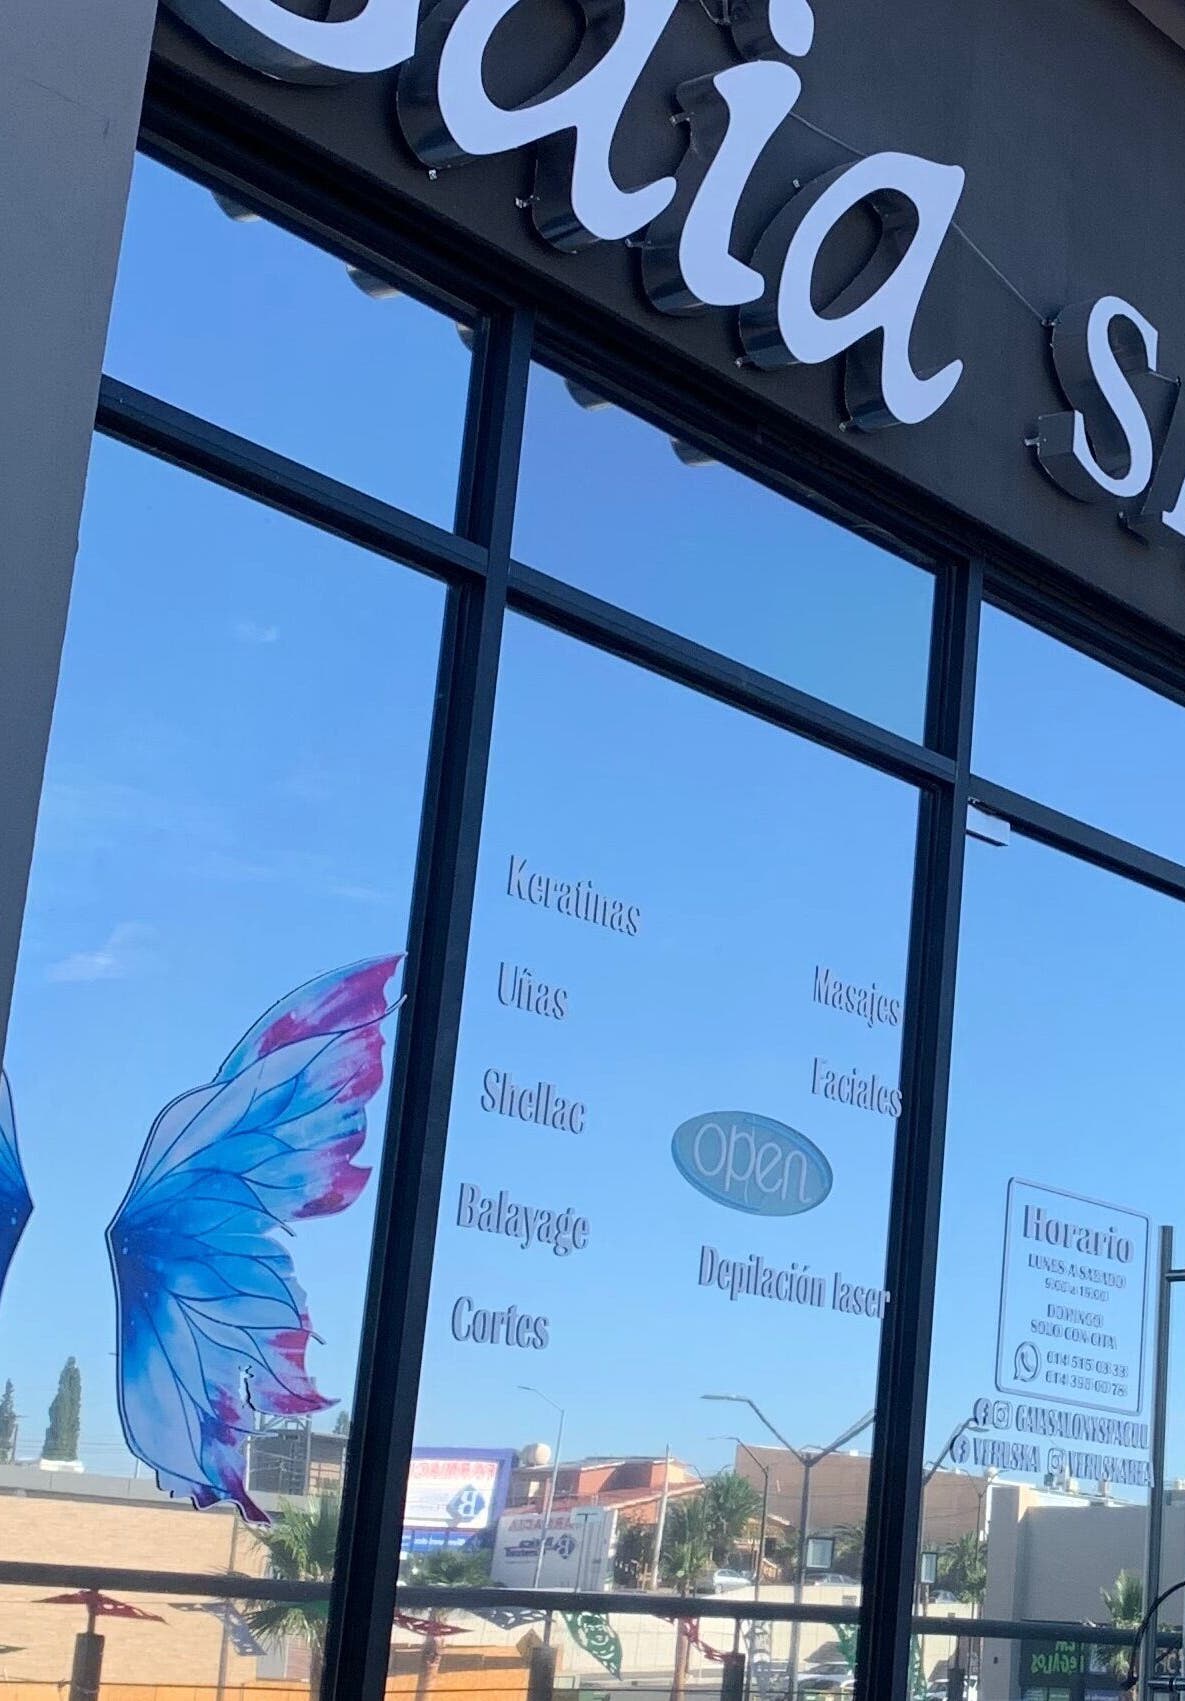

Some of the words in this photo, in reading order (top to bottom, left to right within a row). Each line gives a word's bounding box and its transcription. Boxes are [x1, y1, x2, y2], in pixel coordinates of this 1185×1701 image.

[506, 854, 641, 936] Keratinas
[497, 961, 569, 1020] Uñas
[813, 965, 900, 1028] Masajes
[480, 1067, 588, 1135] Shellac
[811, 1057, 903, 1118] Faciales
[456, 1182, 590, 1257] Balayage
[1022, 1204, 1134, 1264] Horario
[698, 1245, 826, 1308] Depilación
[832, 1271, 892, 1320] laser
[451, 1296, 550, 1351] Cortes
